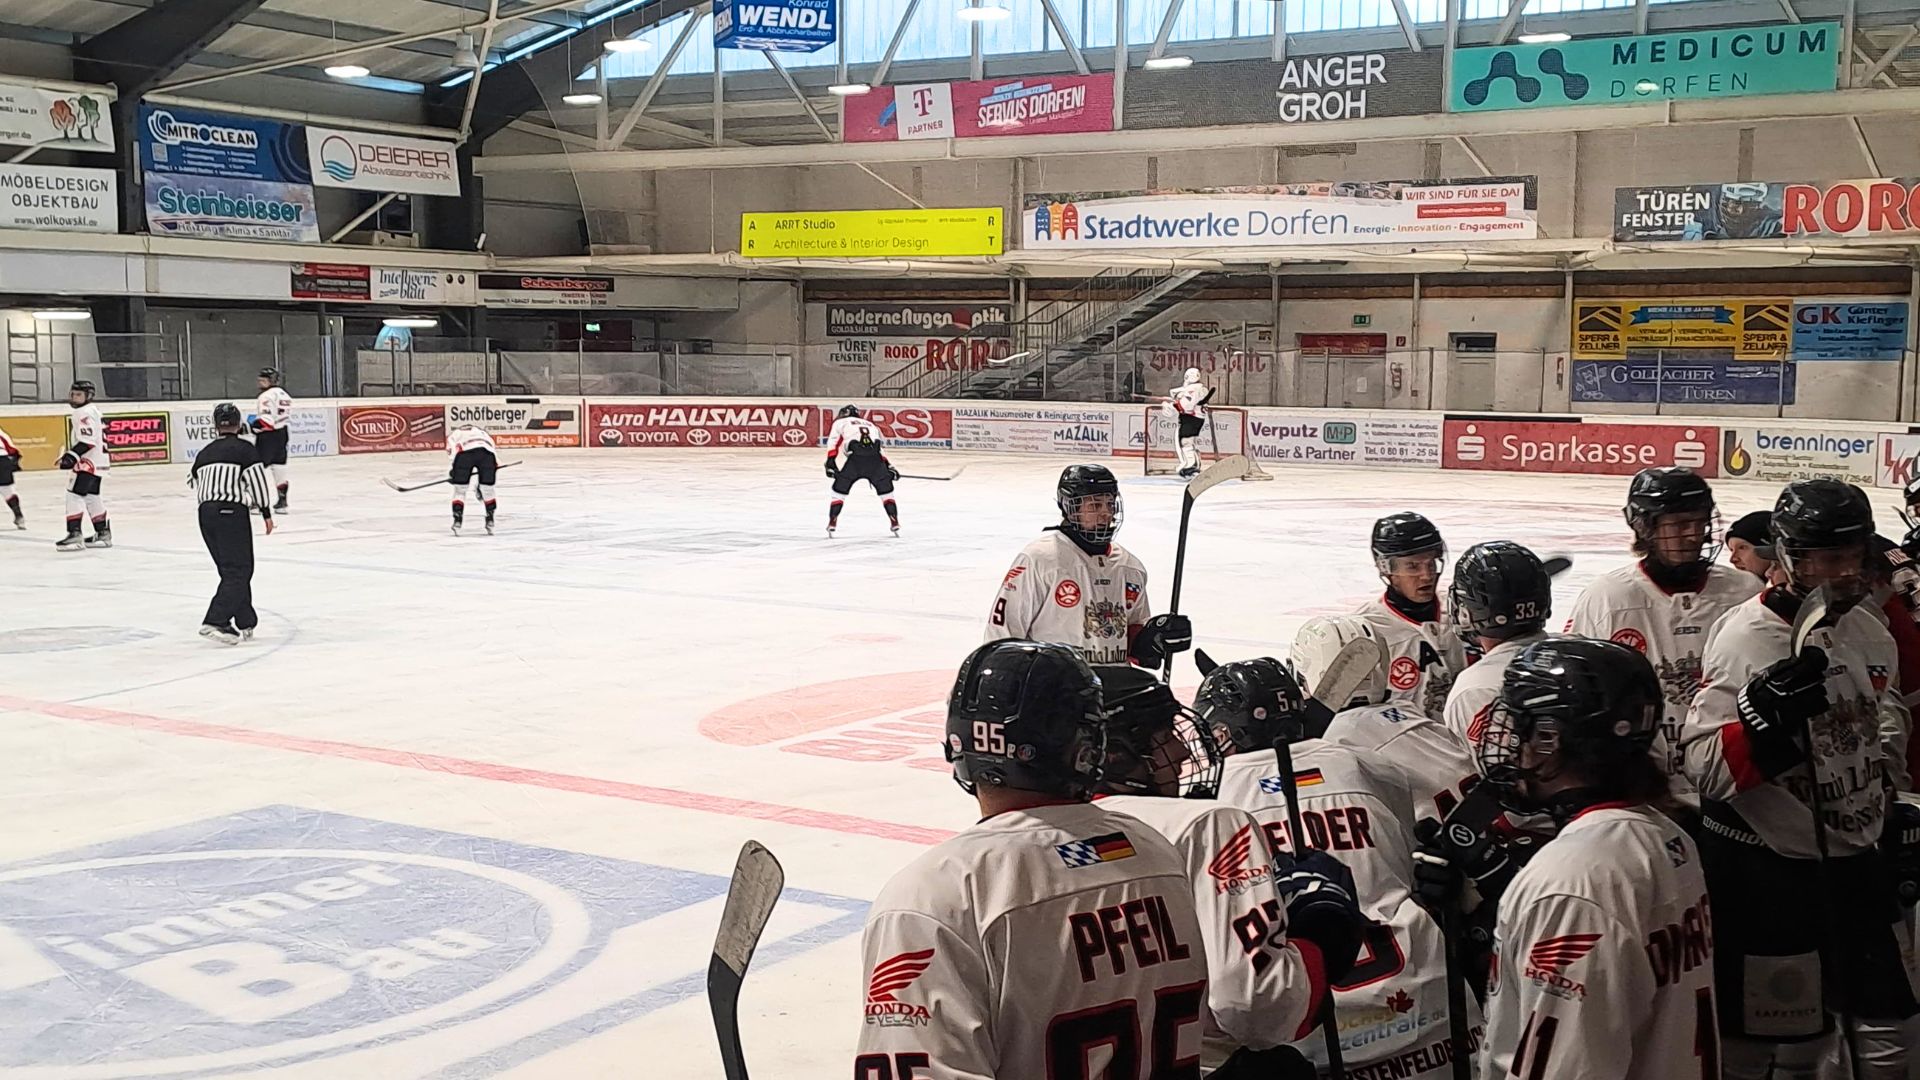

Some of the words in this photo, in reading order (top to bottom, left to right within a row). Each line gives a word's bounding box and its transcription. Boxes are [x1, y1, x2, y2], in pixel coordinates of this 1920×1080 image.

[739, 5, 832, 30] WENDL
[1611, 30, 1826, 65] MEDICUM
[1279, 53, 1387, 89] ANGER
[1610, 73, 1748, 99] DORFEN
[977, 97, 1028, 129] SERVUS
[1029, 85, 1086, 118] DORFEN!
[1278, 90, 1367, 122] GROH
[908, 120, 943, 135] PARTNER
[358, 144, 451, 169] DEIERER
[1, 172, 109, 192] MÖBELDESIGN
[12, 194, 99, 210] OBJEKTBAU
[1405, 191, 1426, 200] WIR
[1428, 190, 1454, 200] SIND
[1457, 187, 1478, 199] FÜR
[1482, 188, 1497, 198] SIE
[1636, 189, 1710, 211] TÜREN
[158, 186, 304, 222] Steinbeisser
[748, 221, 756, 230] A
[775, 219, 799, 230] ARRT
[803, 219, 836, 230] Studio
[988, 216, 995, 226] R
[1084, 211, 1240, 240] Stadtwerke
[1247, 210, 1348, 237] Dorfen
[1353, 224, 1390, 235] Energie
[1397, 222, 1451, 233] Innovation
[1459, 221, 1524, 233] Engagement
[1622, 211, 1695, 227] FENSTER
[748, 239, 755, 249] R
[773, 238, 838, 250] Architecture
[840, 239, 847, 249] &
[850, 237, 888, 249] Interior
[892, 236, 929, 251] Design
[988, 236, 995, 246] T
[1797, 306, 1842, 325] GK
[837, 338, 877, 353] TÜREN
[884, 345, 919, 359] RORO
[830, 353, 869, 362] FENSTER
[1681, 384, 1737, 400] TÜREN
[185, 415, 216, 425] FLIES
[450, 406, 527, 423] Schöfberger
[600, 413, 644, 427] AUTO
[647, 408, 809, 427] HAUSMANN
[955, 408, 988, 419] MAZALIK
[1037, 411, 1042, 419] &
[1082, 413, 1109, 422] Service
[110, 418, 161, 432] SPORT
[186, 427, 218, 440] WEB
[350, 417, 401, 435] STIRNER
[1053, 424, 1109, 442] MAZALIK
[1250, 422, 1318, 440] Verputz
[628, 431, 679, 443] TOYOTA
[719, 431, 776, 443] DORFEN
[1756, 430, 1875, 458] brenninger
[1252, 444, 1289, 459] Müller
[1293, 446, 1302, 459] &
[1306, 446, 1356, 461] Partner
[1502, 434, 1657, 467] Sparkasse
[1515, 601, 1537, 620] 33
[1419, 640, 1444, 673] A
[972, 721, 1006, 753] 95
[1068, 896, 1190, 983] PFEIL
[1524, 967, 1588, 998] HONDA
